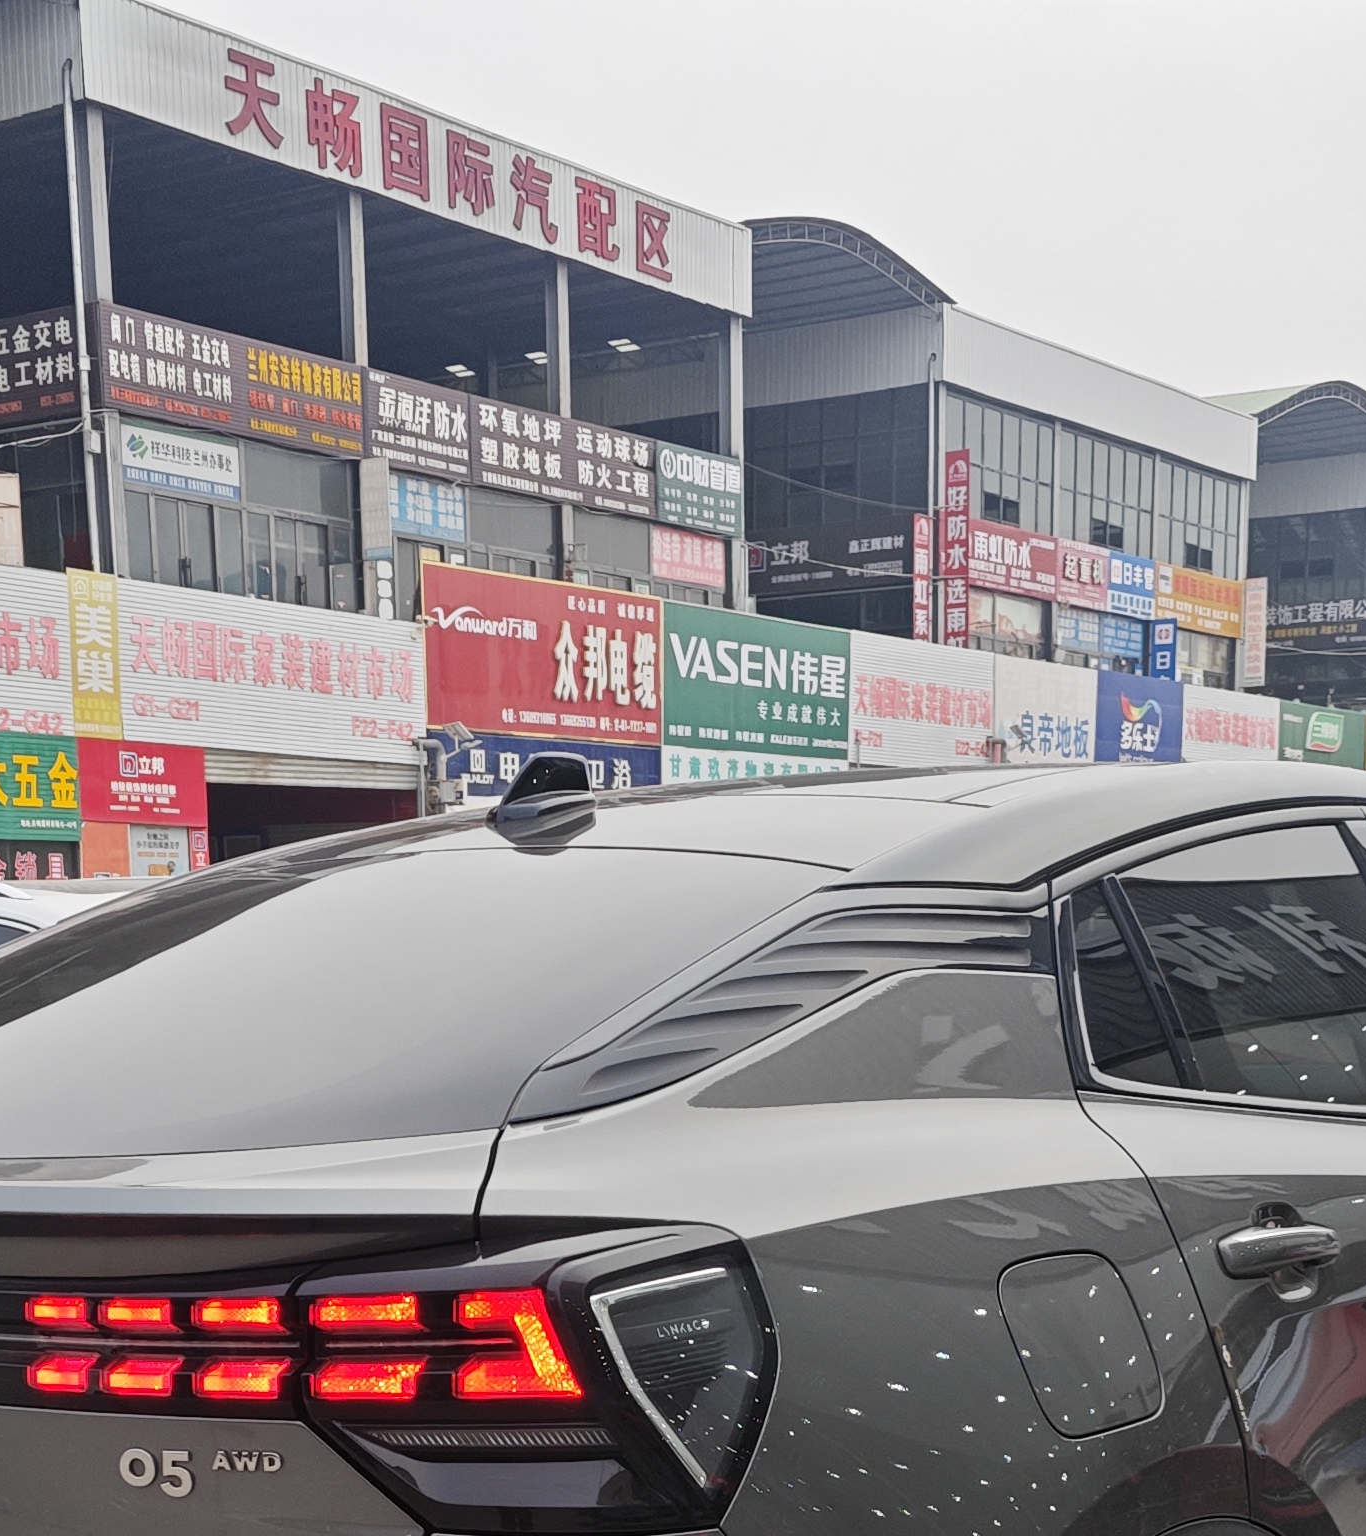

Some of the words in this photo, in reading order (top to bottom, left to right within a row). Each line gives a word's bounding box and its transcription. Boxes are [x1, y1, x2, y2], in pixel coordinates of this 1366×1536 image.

[224, 47, 672, 283] 天畅国际汽配区
[191, 333, 231, 369] 五金交电
[479, 404, 562, 447] 环氧地坪
[576, 426, 649, 467] 运动球场
[480, 437, 562, 480] 塑胶地板
[577, 460, 649, 498] 防火工程
[770, 540, 809, 566] 立邦
[947, 486, 967, 570] 好防水
[974, 531, 1032, 569] 雨虹防水
[914, 550, 929, 641] 雨虹系
[75, 603, 114, 694] 美巢
[131, 615, 415, 703] 天畅国际家装建材市场
[553, 620, 657, 710] 众邦电缆
[757, 700, 841, 727] 专业成就伟大
[1120, 721, 1160, 753] 多乐士
[138, 756, 165, 776] 立邦
[212, 1450, 282, 1472] AWD
